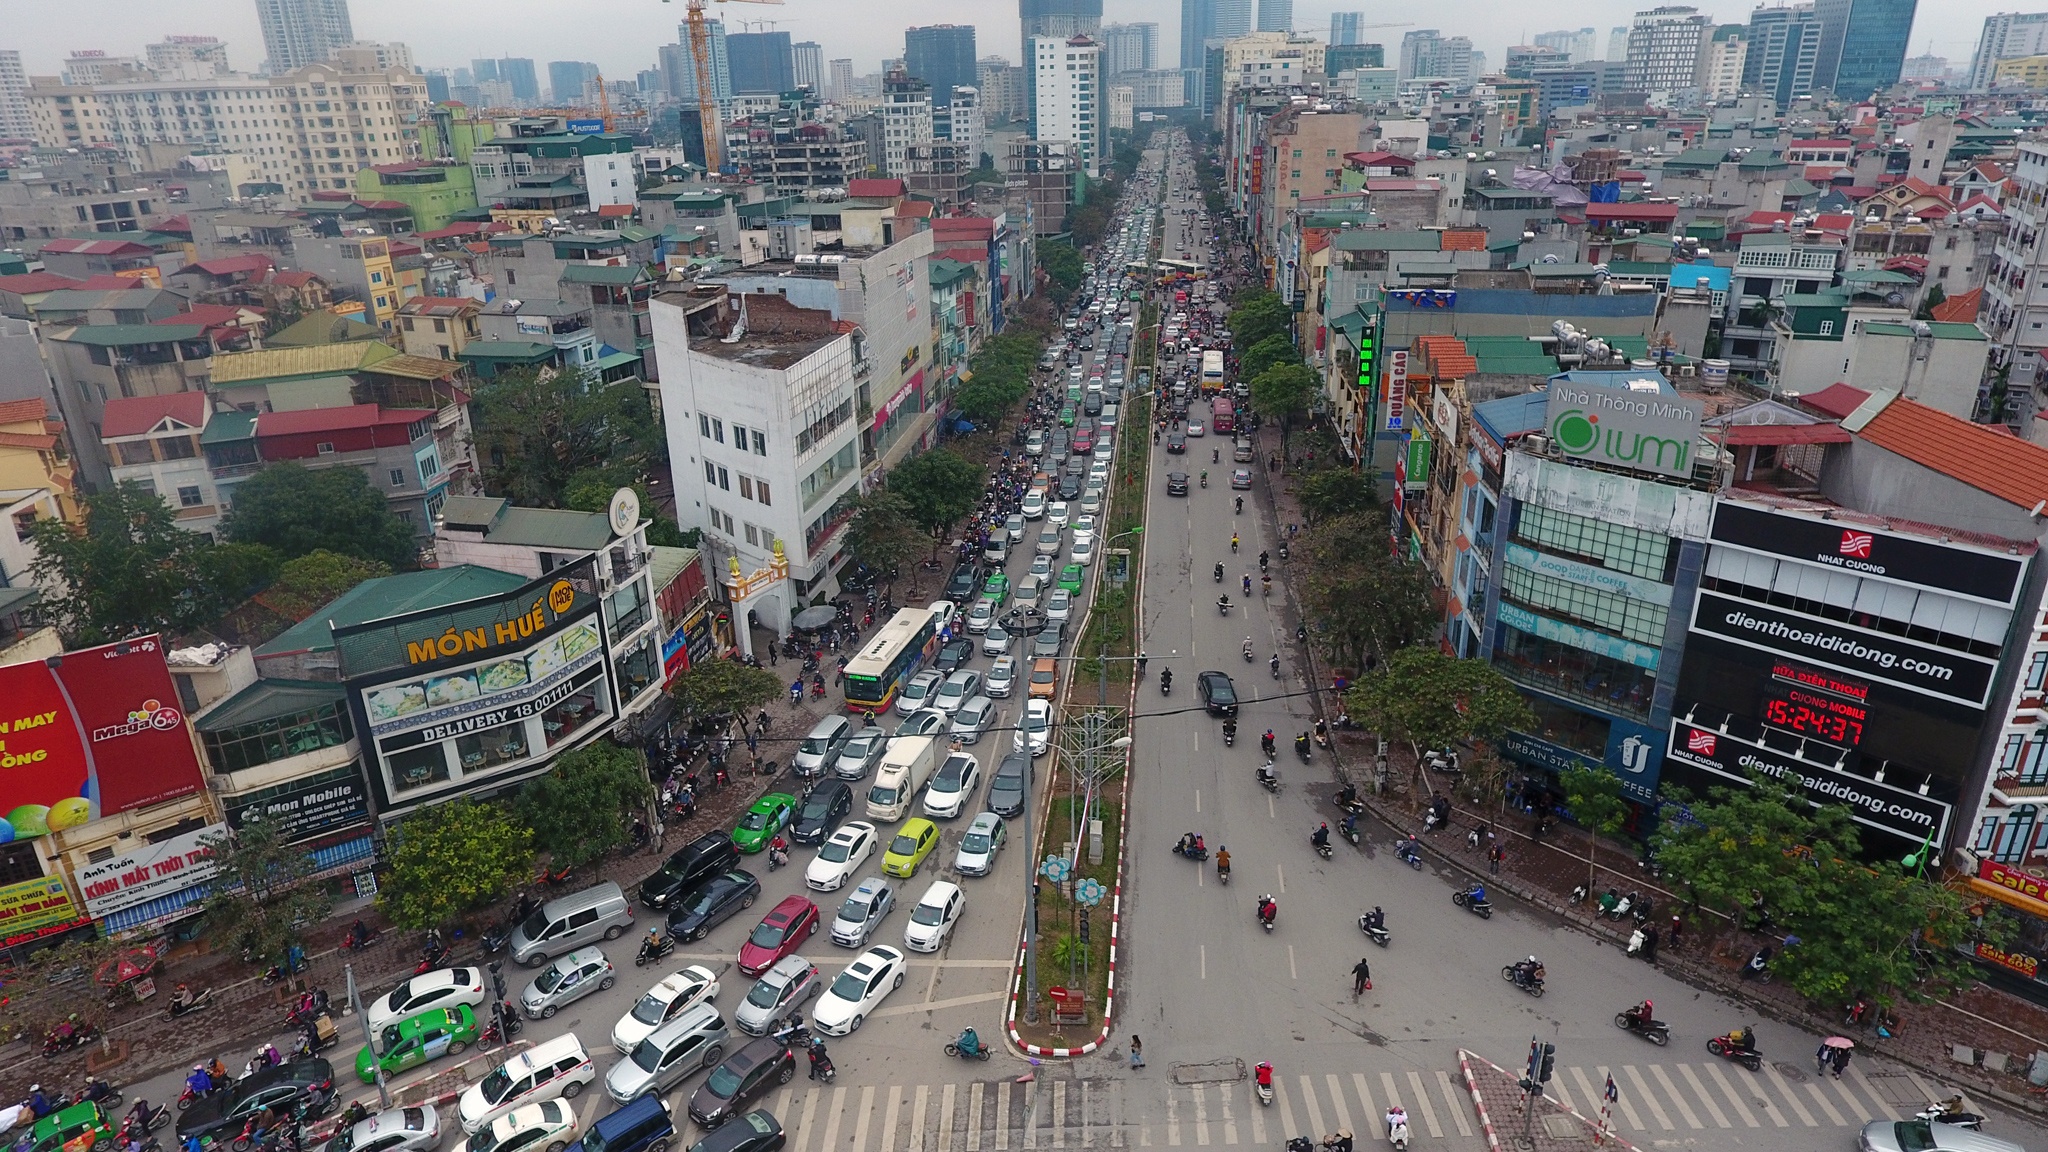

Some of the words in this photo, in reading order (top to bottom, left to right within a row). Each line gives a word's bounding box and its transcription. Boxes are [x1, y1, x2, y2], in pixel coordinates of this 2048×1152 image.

[1392, 352, 1407, 375] CÁO
[1556, 388, 1590, 405] Nhà
[1596, 393, 1649, 417] Thông
[1652, 402, 1694, 422] Minh
[1541, 561, 1568, 573] GOOD
[1817, 553, 1844, 567] NHAT
[1845, 558, 1886, 575] CUONG
[1597, 575, 1628, 589] COFFEE
[1501, 603, 1535, 624] URBAN
[407, 625, 488, 665] MÓN
[495, 596, 546, 646] HUẾ
[1725, 611, 1954, 682] dienthoaididong.com
[1790, 691, 1827, 709] CUONG
[1829, 702, 1866, 720] MOBILE
[14, 711, 57, 732] MAY
[94, 720, 151, 742] Mega
[421, 710, 507, 742] DELIVERY
[1767, 700, 1863, 745] 15:24:37
[0, 749, 48, 768] ỒNG
[1507, 740, 1547, 761] URBAN
[1674, 749, 1694, 762] NHAT
[1695, 755, 1724, 770] CUONG
[267, 800, 299, 815] Mon
[303, 785, 352, 807] Mobile
[83, 867, 105, 880] Anh
[106, 858, 134, 872] Tuấn
[84, 877, 119, 900] KÍNH
[122, 865, 151, 887] MẮT
[153, 855, 184, 877] THỜI
[1991, 869, 2039, 897] Sale
[1981, 946, 2005, 961] Sale
[2007, 957, 2033, 973] 60%
